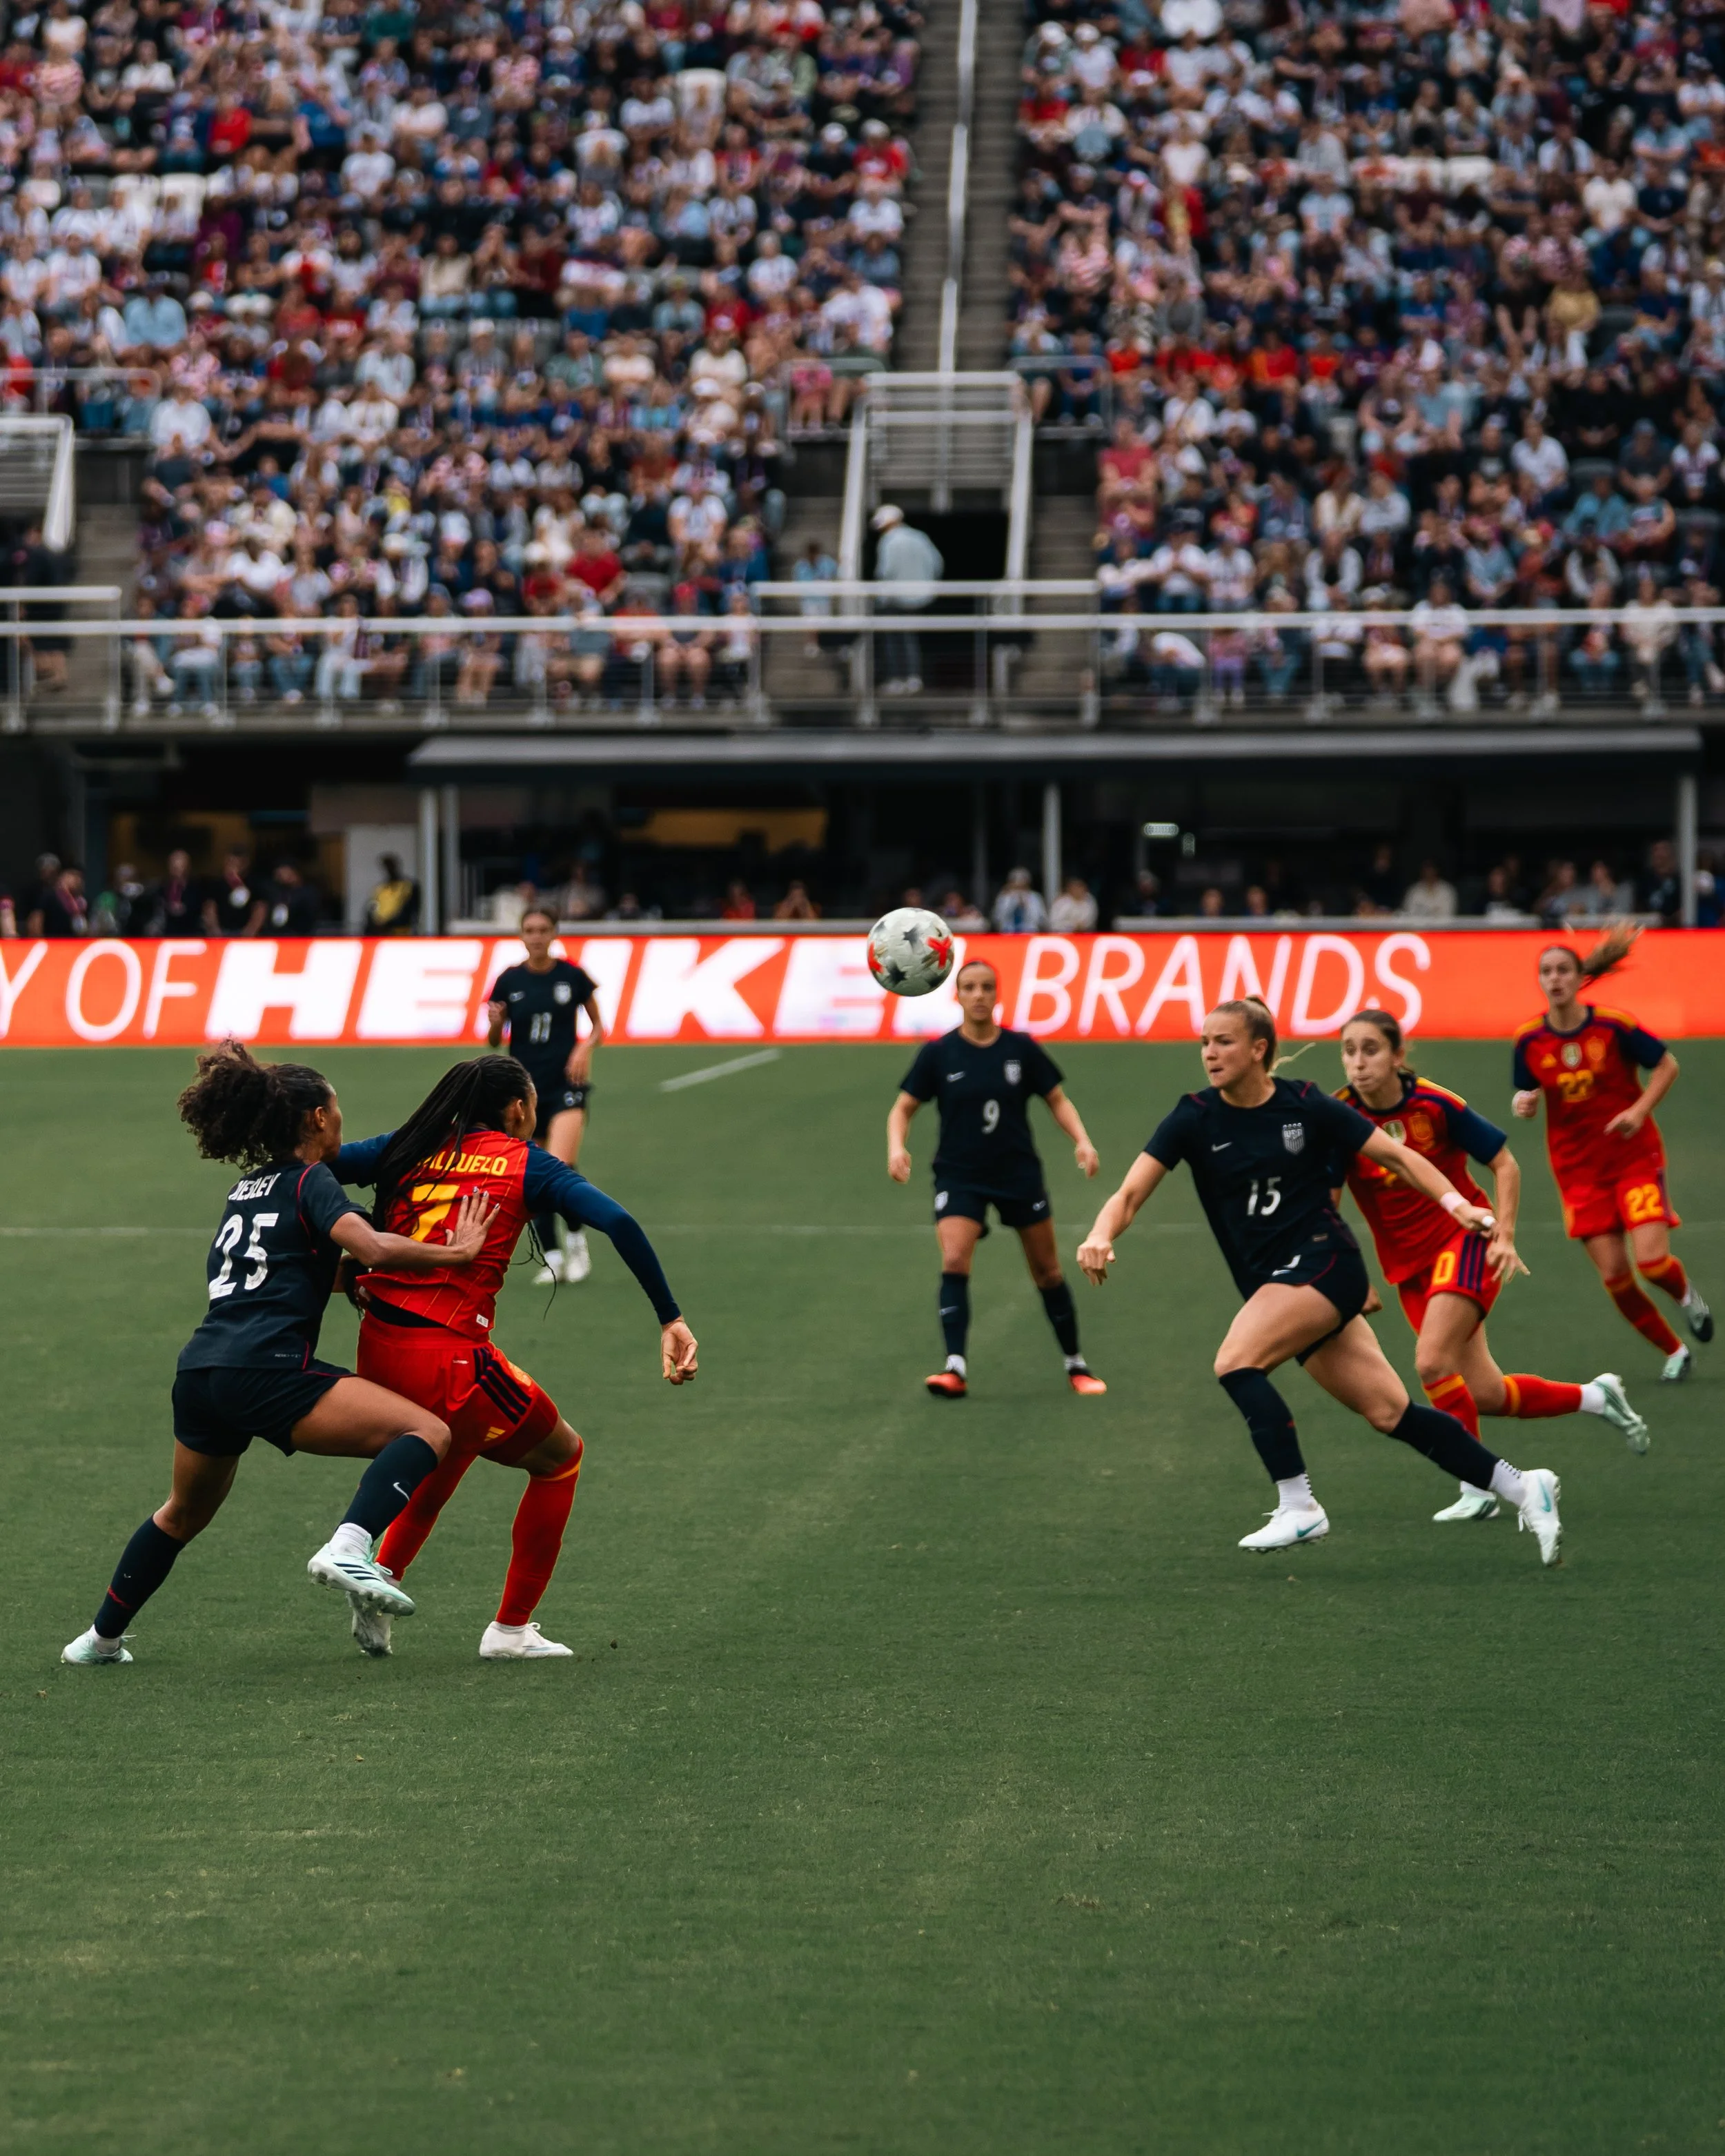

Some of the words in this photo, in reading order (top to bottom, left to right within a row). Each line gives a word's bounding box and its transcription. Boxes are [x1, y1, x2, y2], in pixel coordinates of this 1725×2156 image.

[65, 938, 207, 1041] OF
[1013, 933, 1431, 1036] BRANDS
[1557, 1069, 1593, 1102] 22
[982, 1099, 1000, 1134] 9
[409, 1183, 460, 1242] 7
[1247, 1176, 1281, 1216] 15
[1624, 1183, 1664, 1223] 22
[208, 1213, 279, 1300] 25
